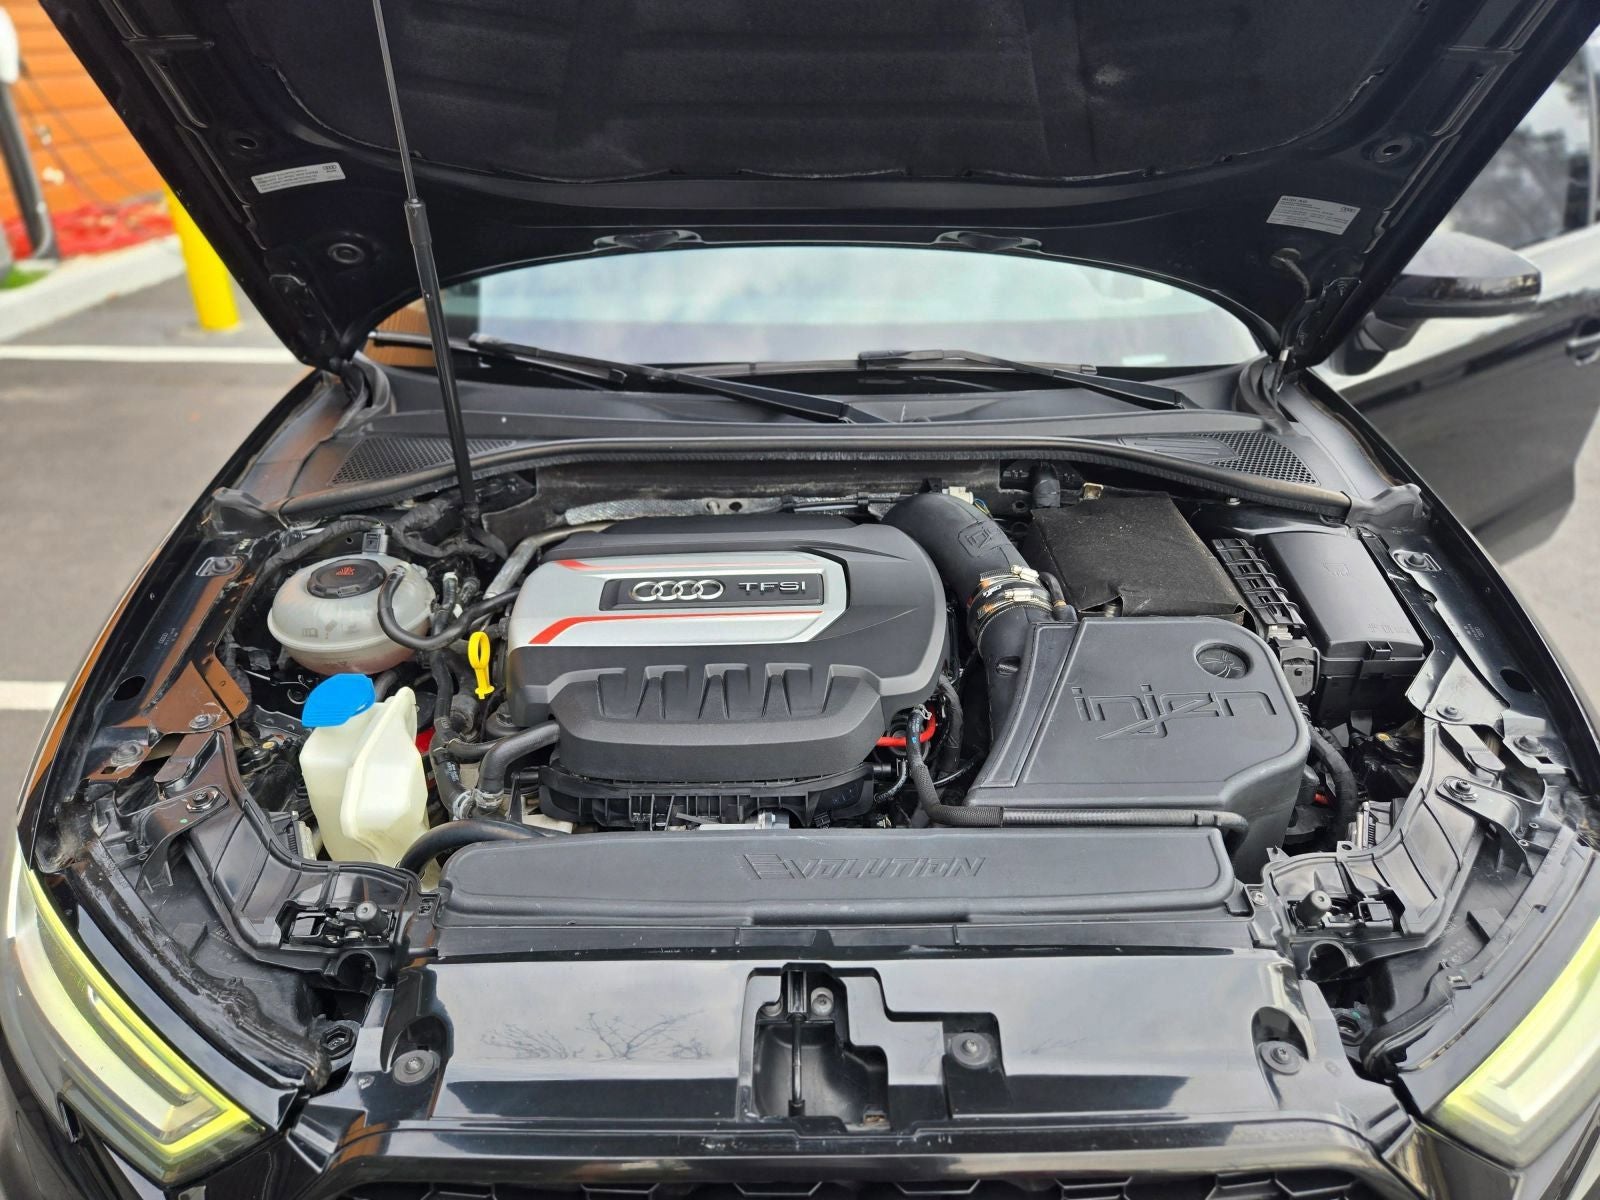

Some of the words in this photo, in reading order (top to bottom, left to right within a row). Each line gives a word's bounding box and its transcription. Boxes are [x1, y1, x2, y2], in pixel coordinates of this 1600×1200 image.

[738, 581, 806, 593] TFSI
[1071, 684, 1277, 740] injen
[743, 853, 986, 880] EVOLUTION
